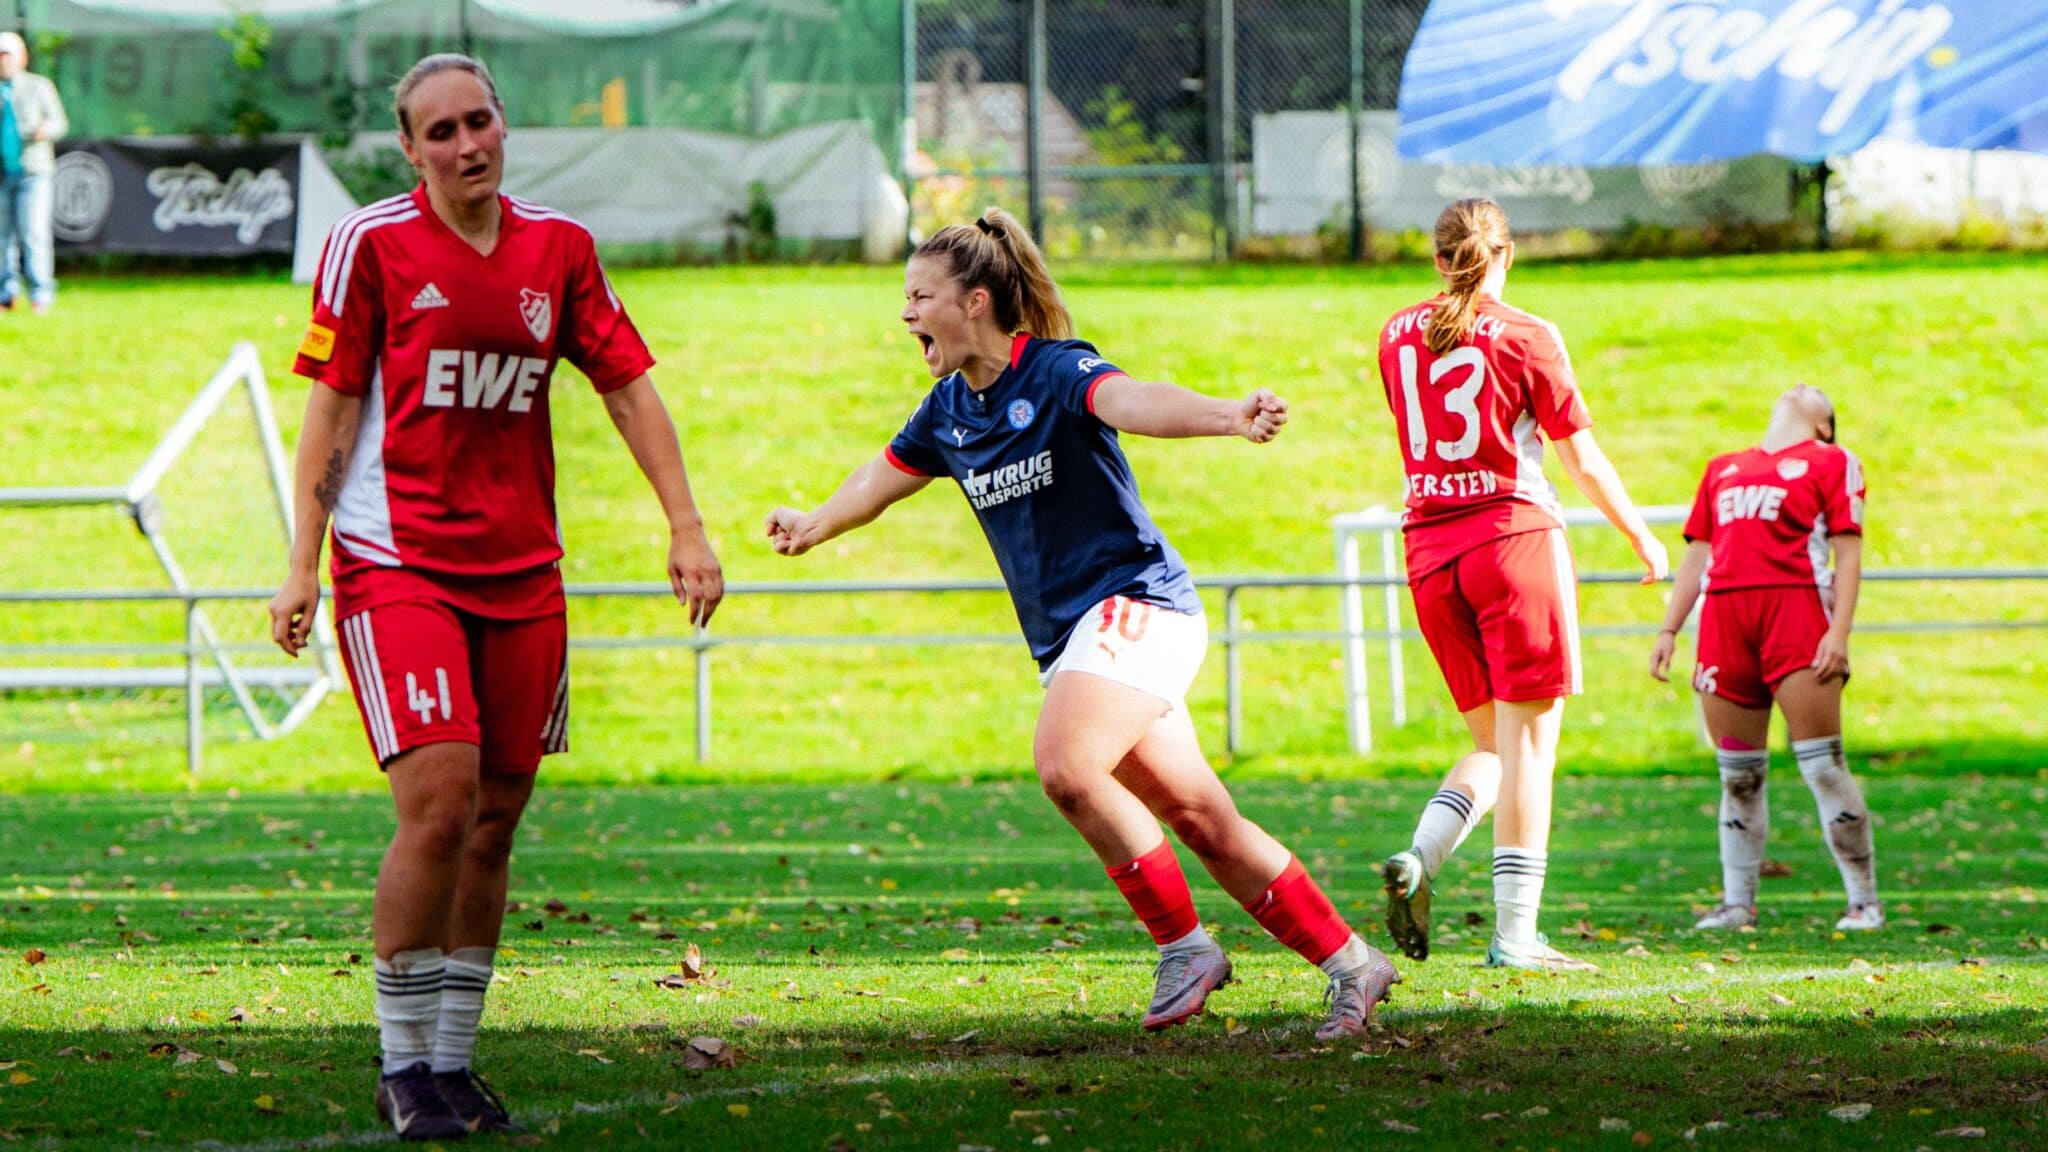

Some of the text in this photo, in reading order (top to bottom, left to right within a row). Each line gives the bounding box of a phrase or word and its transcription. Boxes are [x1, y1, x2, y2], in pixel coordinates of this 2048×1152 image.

[422, 349, 549, 413] EWE
[1399, 345, 1485, 462] 13
[971, 470, 1053, 510] RANSPORTE
[993, 450, 1053, 491] KRUG
[1410, 469, 1497, 498] ERSTEN
[1717, 485, 1788, 526] EWE
[406, 667, 452, 724] 41
